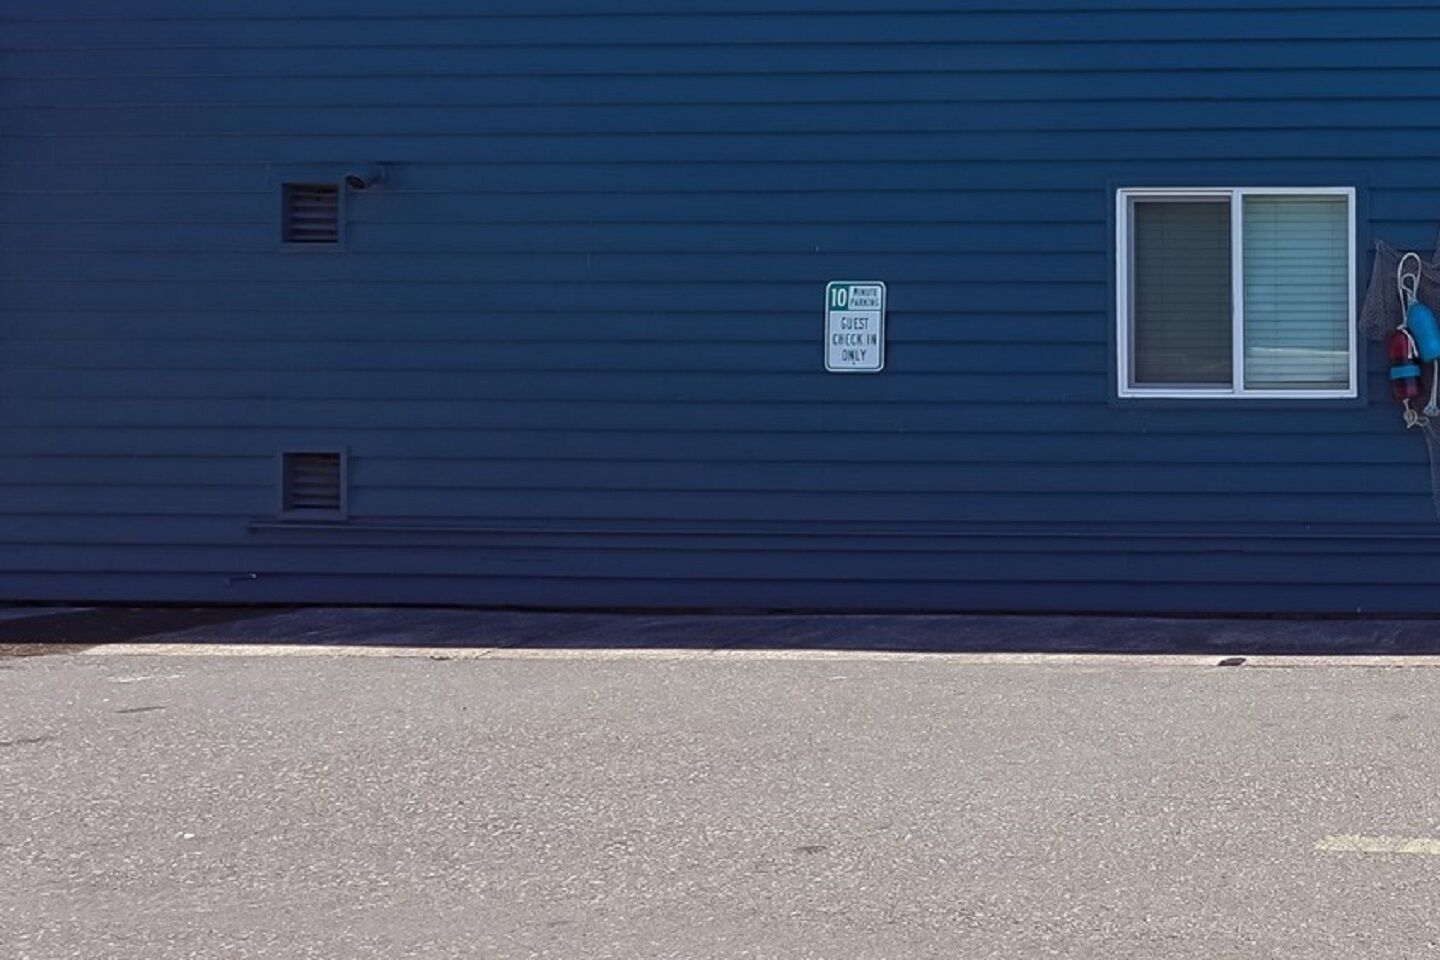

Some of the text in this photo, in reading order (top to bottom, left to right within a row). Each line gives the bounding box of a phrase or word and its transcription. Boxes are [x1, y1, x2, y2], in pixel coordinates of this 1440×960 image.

[832, 288, 847, 307] 10
[853, 288, 878, 297] MINUTE
[850, 298, 879, 307] PARKING
[841, 317, 869, 330] GUEST
[832, 333, 877, 346] CHECK IN
[842, 349, 867, 361] ONLY
